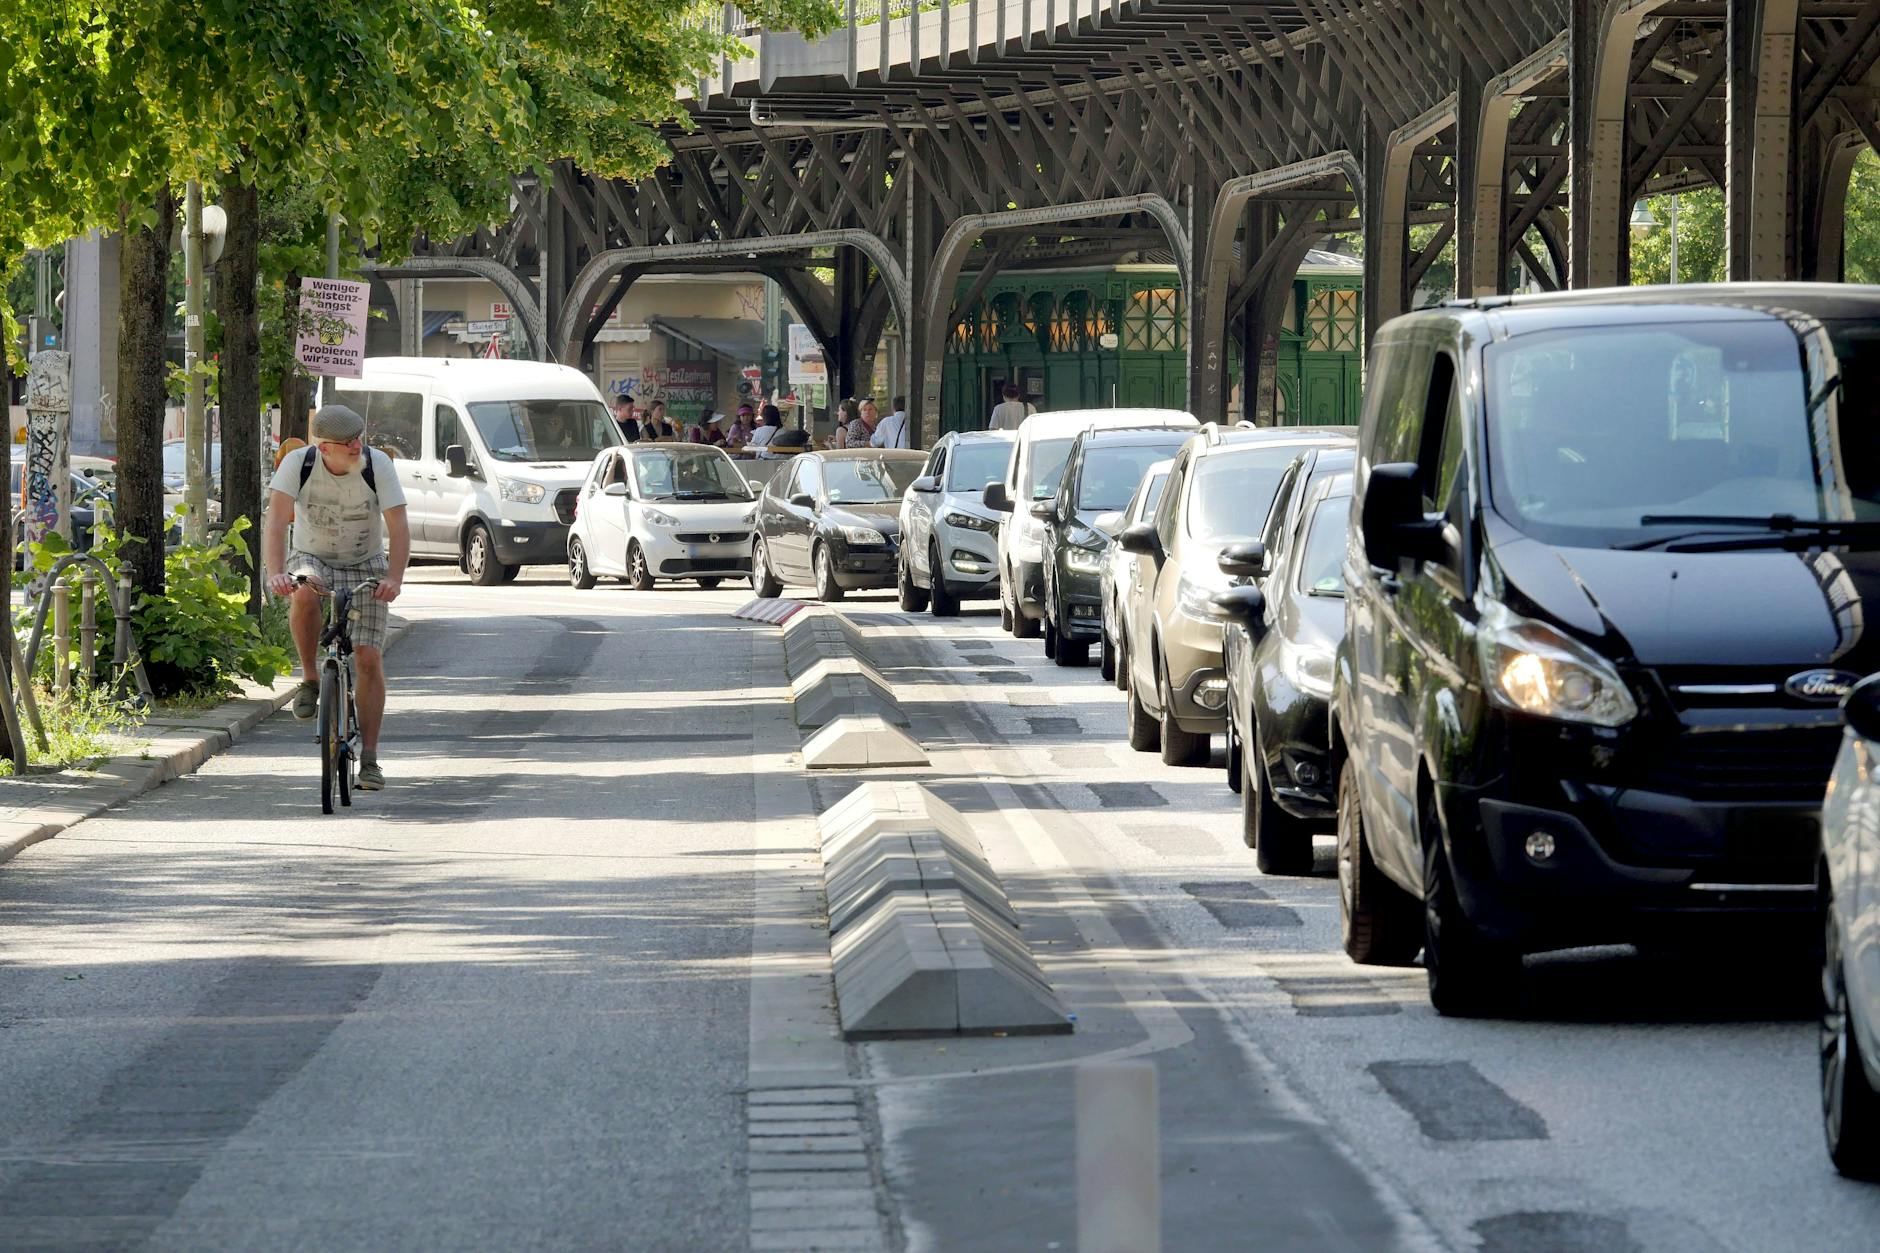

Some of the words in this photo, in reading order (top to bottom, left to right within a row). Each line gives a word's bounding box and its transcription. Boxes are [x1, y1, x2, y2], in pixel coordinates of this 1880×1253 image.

[313, 281, 360, 293] Weniger
[309, 290, 362, 303] xistenz-
[317, 301, 351, 311] angst
[302, 344, 358, 357] Probieren
[303, 354, 330, 364] wir's
[332, 357, 356, 366] aus.
[1803, 674, 1852, 695] Ford
